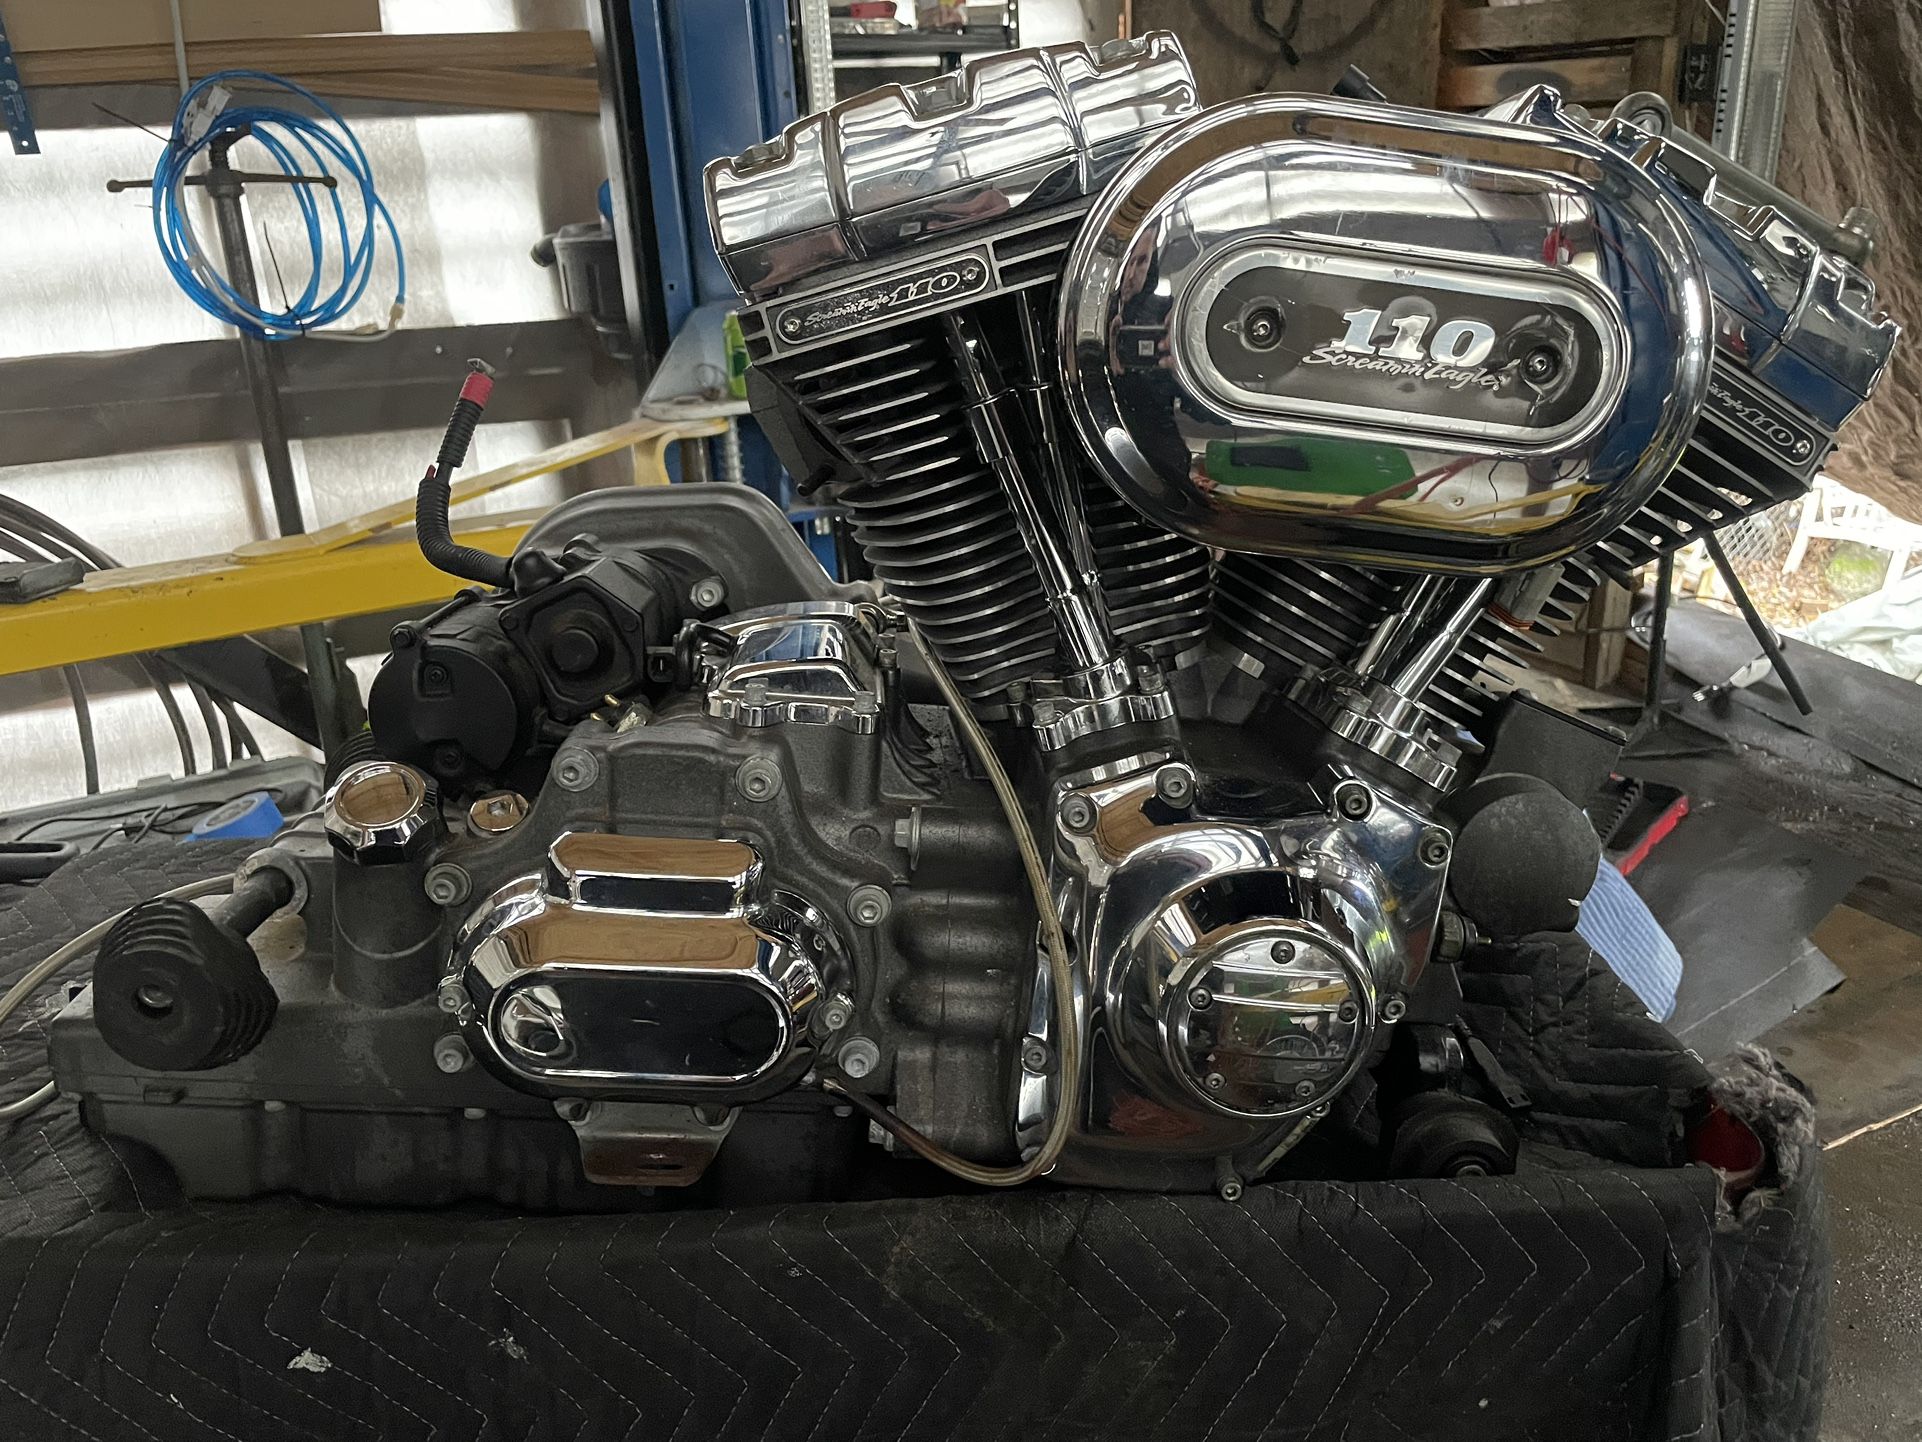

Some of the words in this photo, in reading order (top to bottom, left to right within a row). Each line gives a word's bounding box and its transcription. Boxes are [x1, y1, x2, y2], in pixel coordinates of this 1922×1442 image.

[857, 294, 890, 312] Eagle
[888, 271, 961, 306] 110
[1331, 308, 1497, 367] 110
[1423, 360, 1500, 390] Eagle
[1736, 407, 1795, 446] 110
